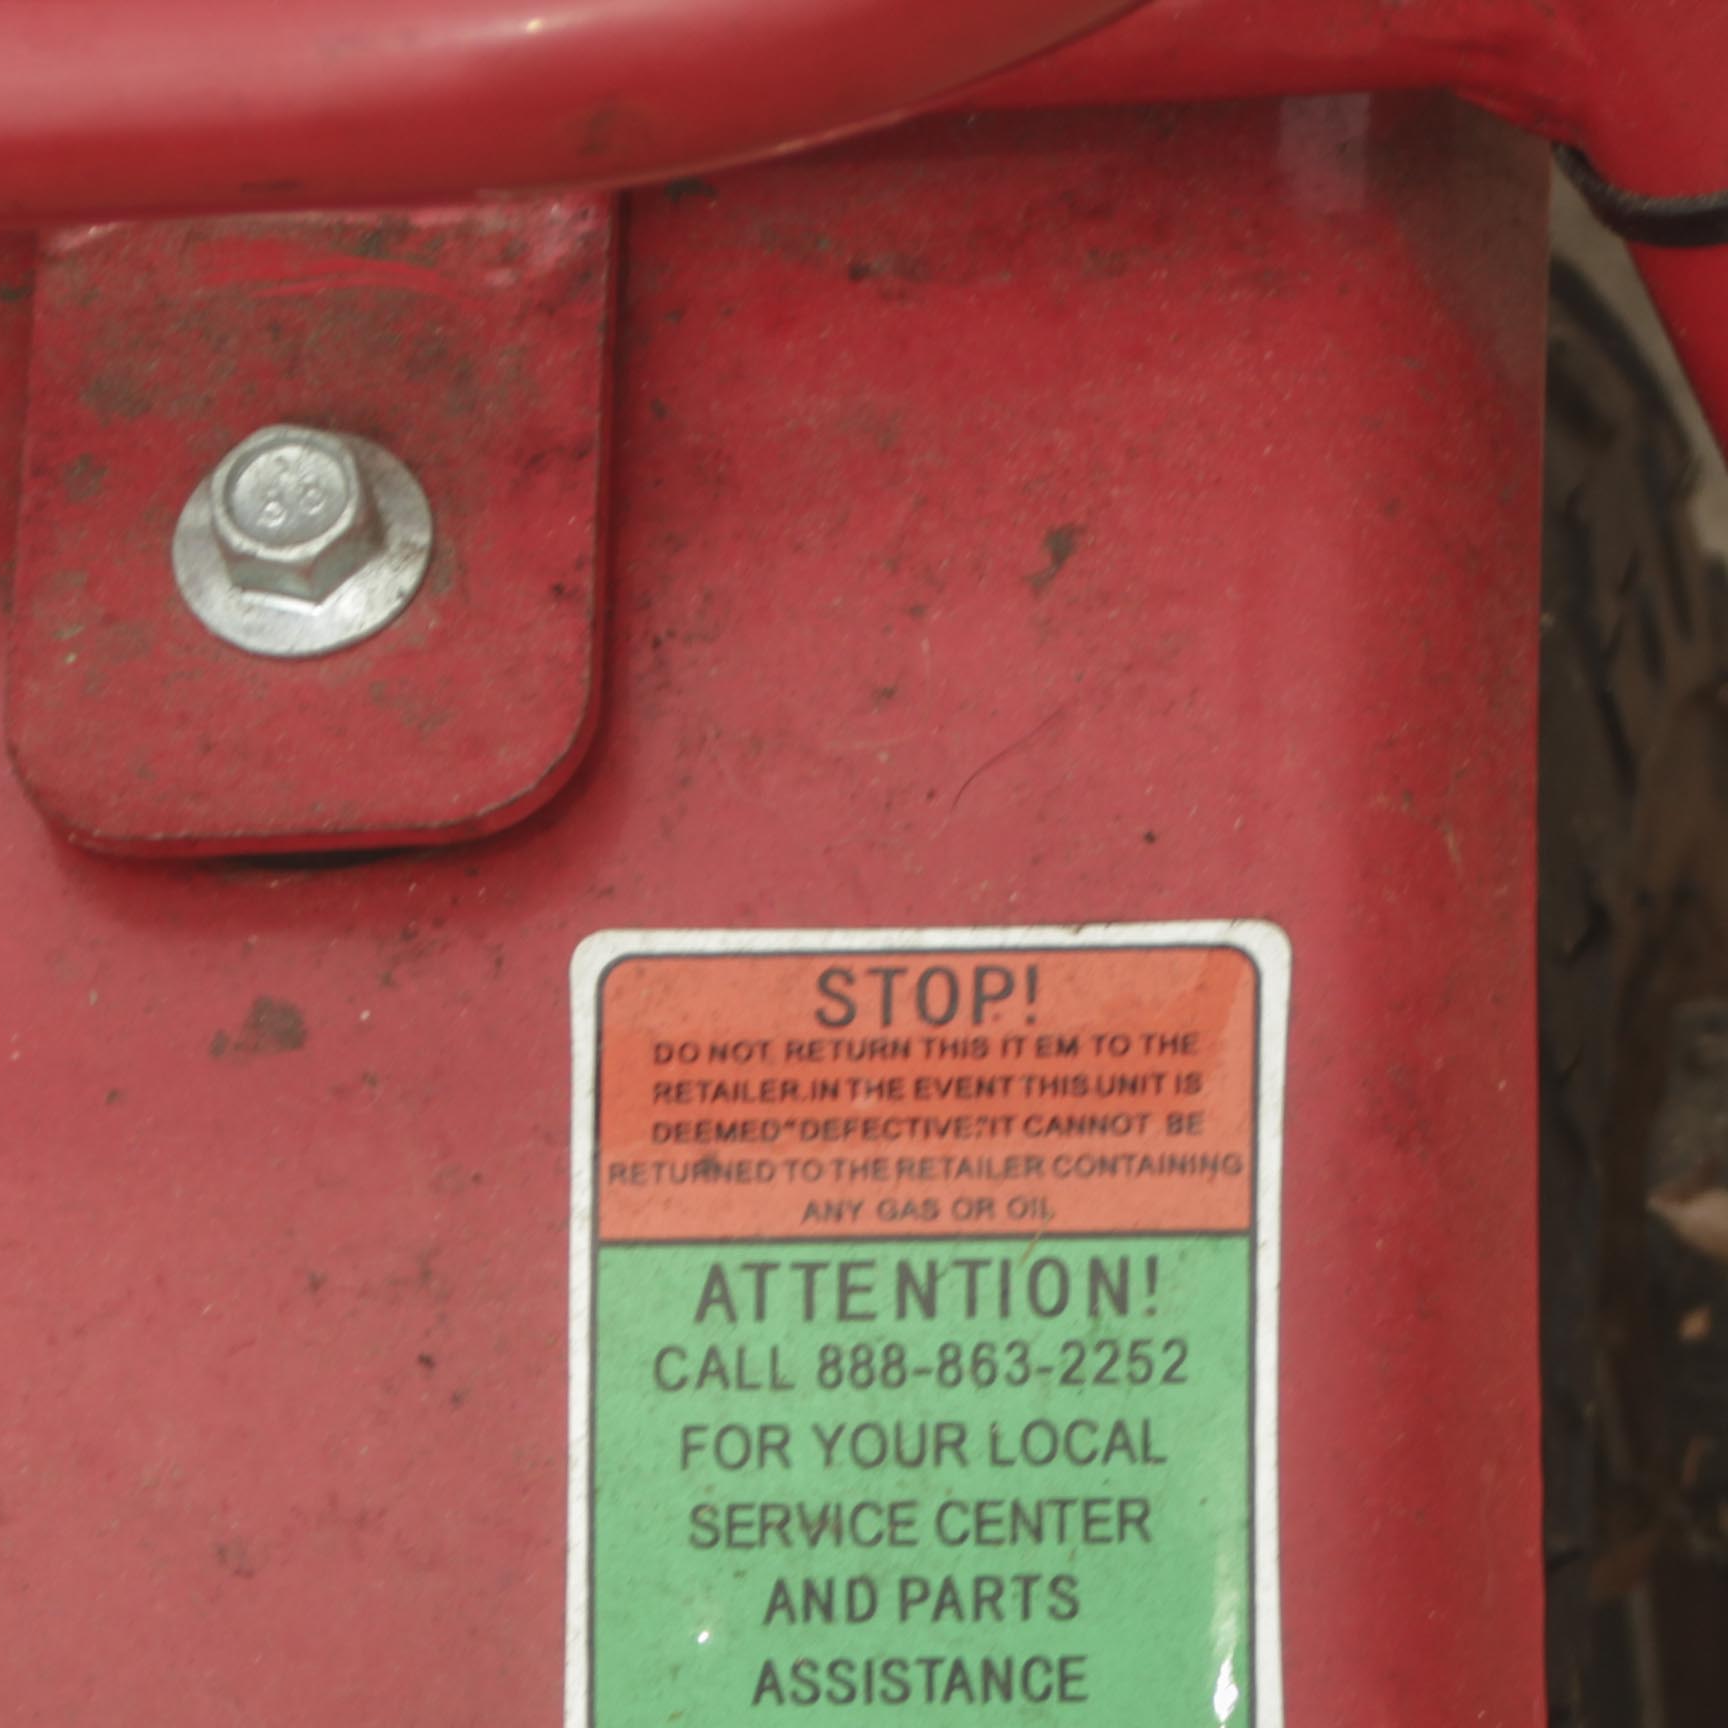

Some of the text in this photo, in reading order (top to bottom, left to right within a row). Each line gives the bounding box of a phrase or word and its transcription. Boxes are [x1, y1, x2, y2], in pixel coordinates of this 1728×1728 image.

[815, 964, 1038, 1028] STOP!
[653, 1031, 1200, 1065] DO NOT RETURN THIS ITEM TO THE
[847, 1076, 904, 1101] THE
[915, 1075, 1015, 1100] EVENT
[1017, 1073, 1089, 1098] THIS
[1095, 1072, 1168, 1096] UNIT
[1176, 1071, 1203, 1095] IS
[652, 1119, 780, 1145] DEEMED
[1023, 1113, 1151, 1138] CANNOT
[1165, 1111, 1205, 1136] BE
[608, 1152, 1244, 1184] RETURNED TO THE RETAILER CONTAINING
[800, 1199, 864, 1224] ANY
[876, 1197, 940, 1222] GAS
[951, 1196, 996, 1221] OR
[693, 1255, 1160, 1323] ATTENTION!
[653, 1337, 1191, 1392] CALL 888-863-2252
[679, 1417, 1169, 1472] FOR YOUR LOCAL
[687, 1498, 1153, 1551] SERVICE CENTER
[762, 1573, 1081, 1626] AND PARTS
[750, 1655, 1091, 1707] ASSISTANCE
